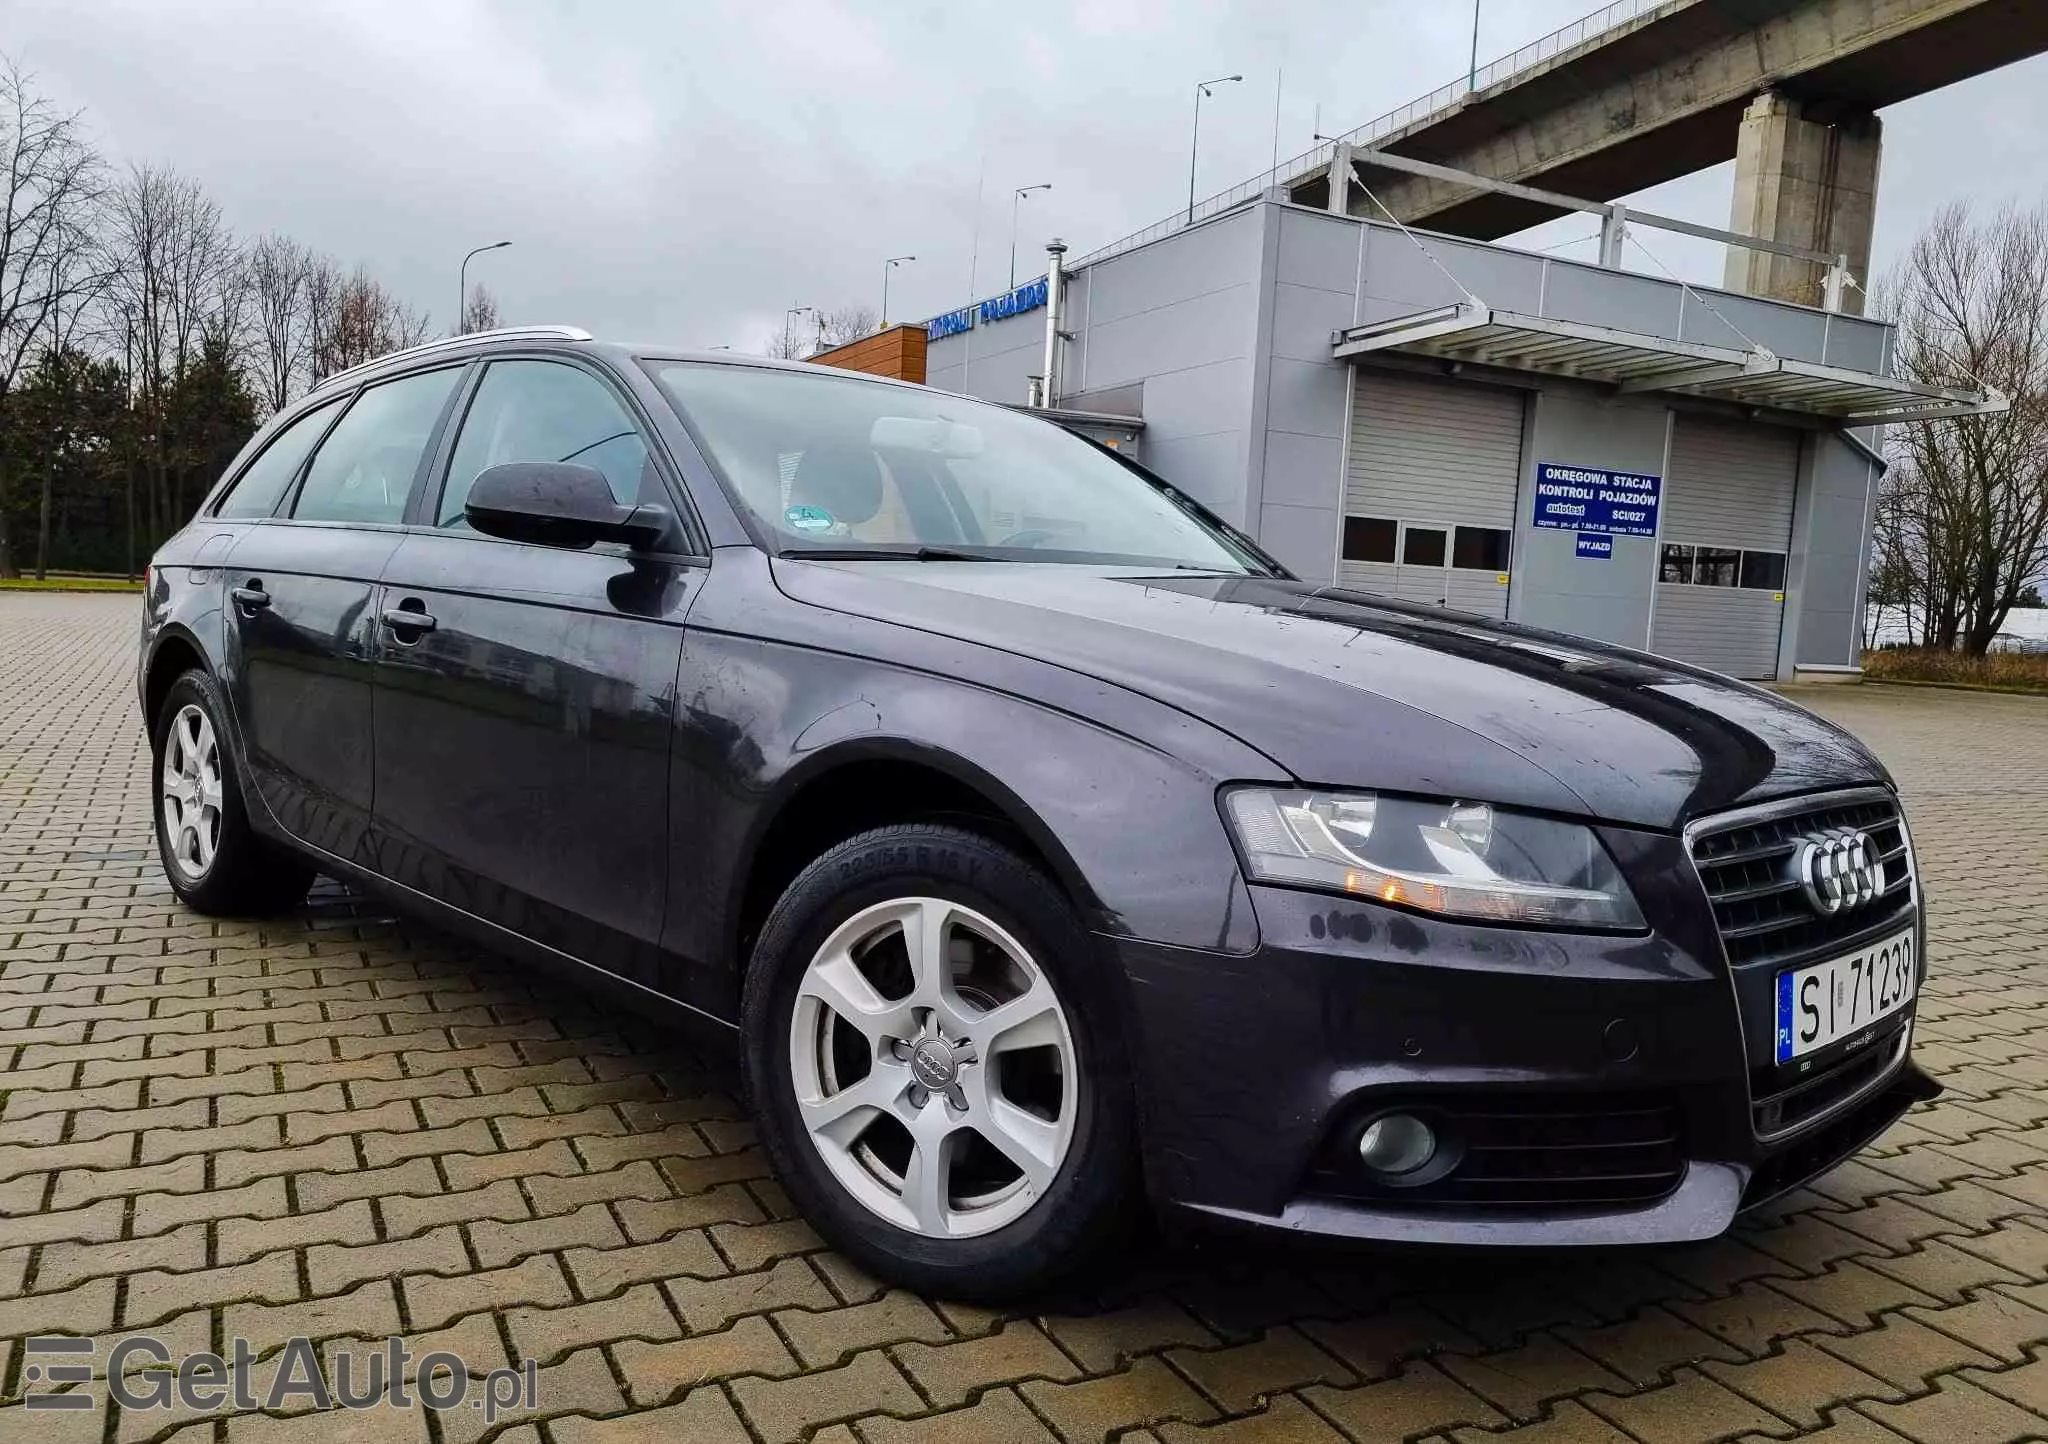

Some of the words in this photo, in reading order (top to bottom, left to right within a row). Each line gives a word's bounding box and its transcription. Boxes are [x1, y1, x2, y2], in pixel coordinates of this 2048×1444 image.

[1546, 468, 1608, 485] OKRĘGOWA
[1613, 475, 1652, 490] STACJA
[1538, 483, 1594, 500] KONTROLI
[1599, 490, 1657, 506] POJAZDÓW
[1546, 502, 1585, 516] autotest
[1612, 510, 1646, 522] SCI/027
[1578, 540, 1611, 551] WYJAZD
[1800, 969, 1835, 1044] SI
[1850, 937, 1911, 1025] 71239
[1779, 1028, 1791, 1047] PL
